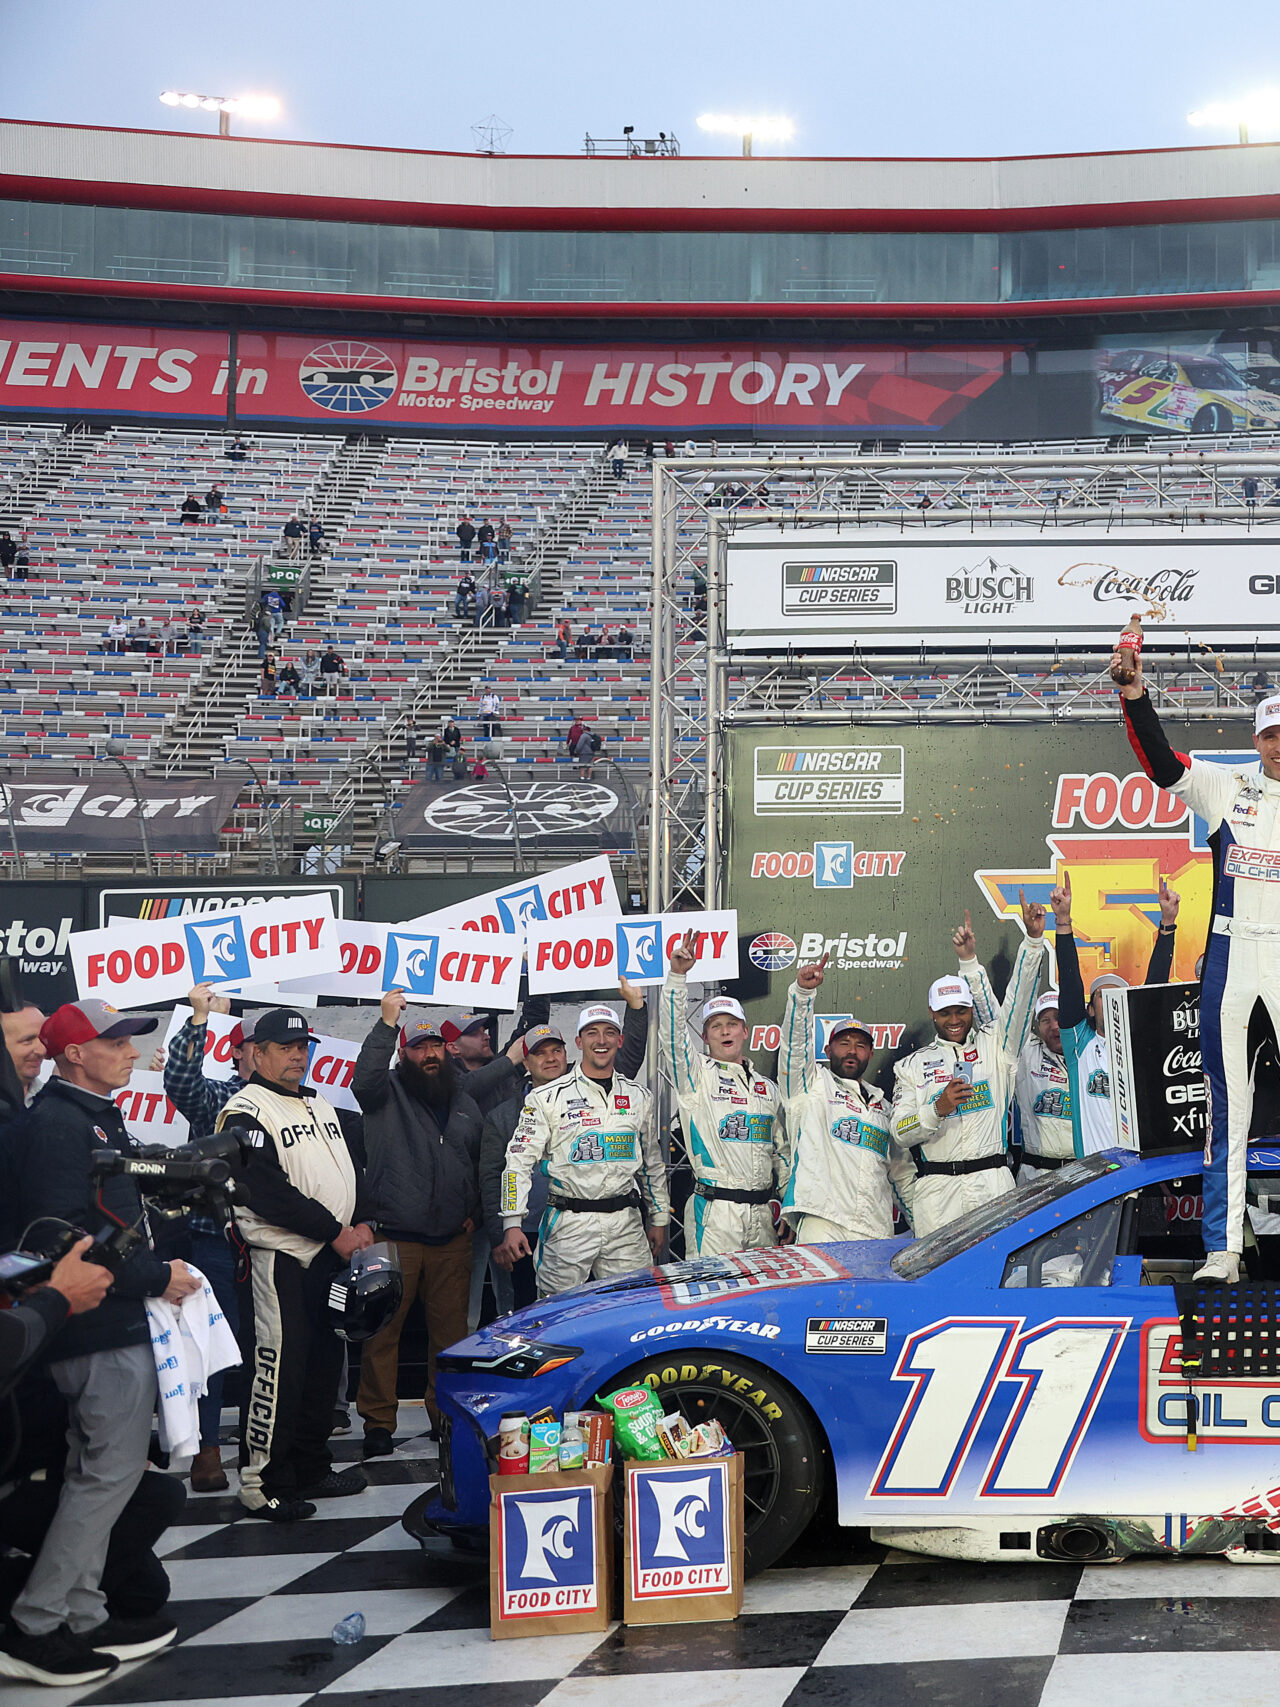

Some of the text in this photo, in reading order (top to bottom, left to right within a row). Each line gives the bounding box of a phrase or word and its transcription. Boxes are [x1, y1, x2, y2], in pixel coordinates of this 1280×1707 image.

[0, 339, 269, 395] ENTS in
[403, 357, 564, 396] Bristol
[584, 361, 866, 407] HISTORY
[398, 393, 555, 414] Motor Speedway
[819, 565, 879, 582] NASCAR
[799, 585, 880, 604] CUP SERIES
[945, 577, 1034, 603] BUSCH
[963, 602, 1016, 615] LIGHT
[802, 752, 882, 771] NASCAR
[774, 781, 884, 801] CUP SERIES
[82, 795, 217, 819] CITY
[1232, 803, 1258, 817] FedEx
[752, 853, 814, 877] FOOD
[853, 852, 907, 877] CITY
[1226, 862, 1247, 875] OIL
[546, 876, 605, 920] CITY
[88, 942, 185, 988] FOOD
[250, 917, 325, 960] CITY
[536, 938, 614, 971] FOOD
[799, 932, 908, 958] Bristol
[439, 950, 513, 985] CITY
[797, 958, 902, 971] Motr Speedway
[1111, 997, 1125, 1070] SERIES
[923, 1068, 945, 1080] FedEx
[1118, 1072, 1128, 1112] CUP
[568, 1109, 591, 1120] FedEx
[129, 1161, 167, 1175] RONIN
[507, 1172, 518, 1211] MAVIS
[629, 1316, 782, 1343] GOODYEAR
[833, 1320, 877, 1331] NASCAR
[817, 1335, 876, 1346] CUP SERIES
[250, 1347, 277, 1455] OFFICIAL
[636, 1365, 784, 1421] OODYEAR
[865, 1315, 1134, 1501] 11
[1157, 1392, 1248, 1428] OIL
[641, 1567, 723, 1588] FOOD CITY
[508, 1588, 592, 1610] FOOD CITY
